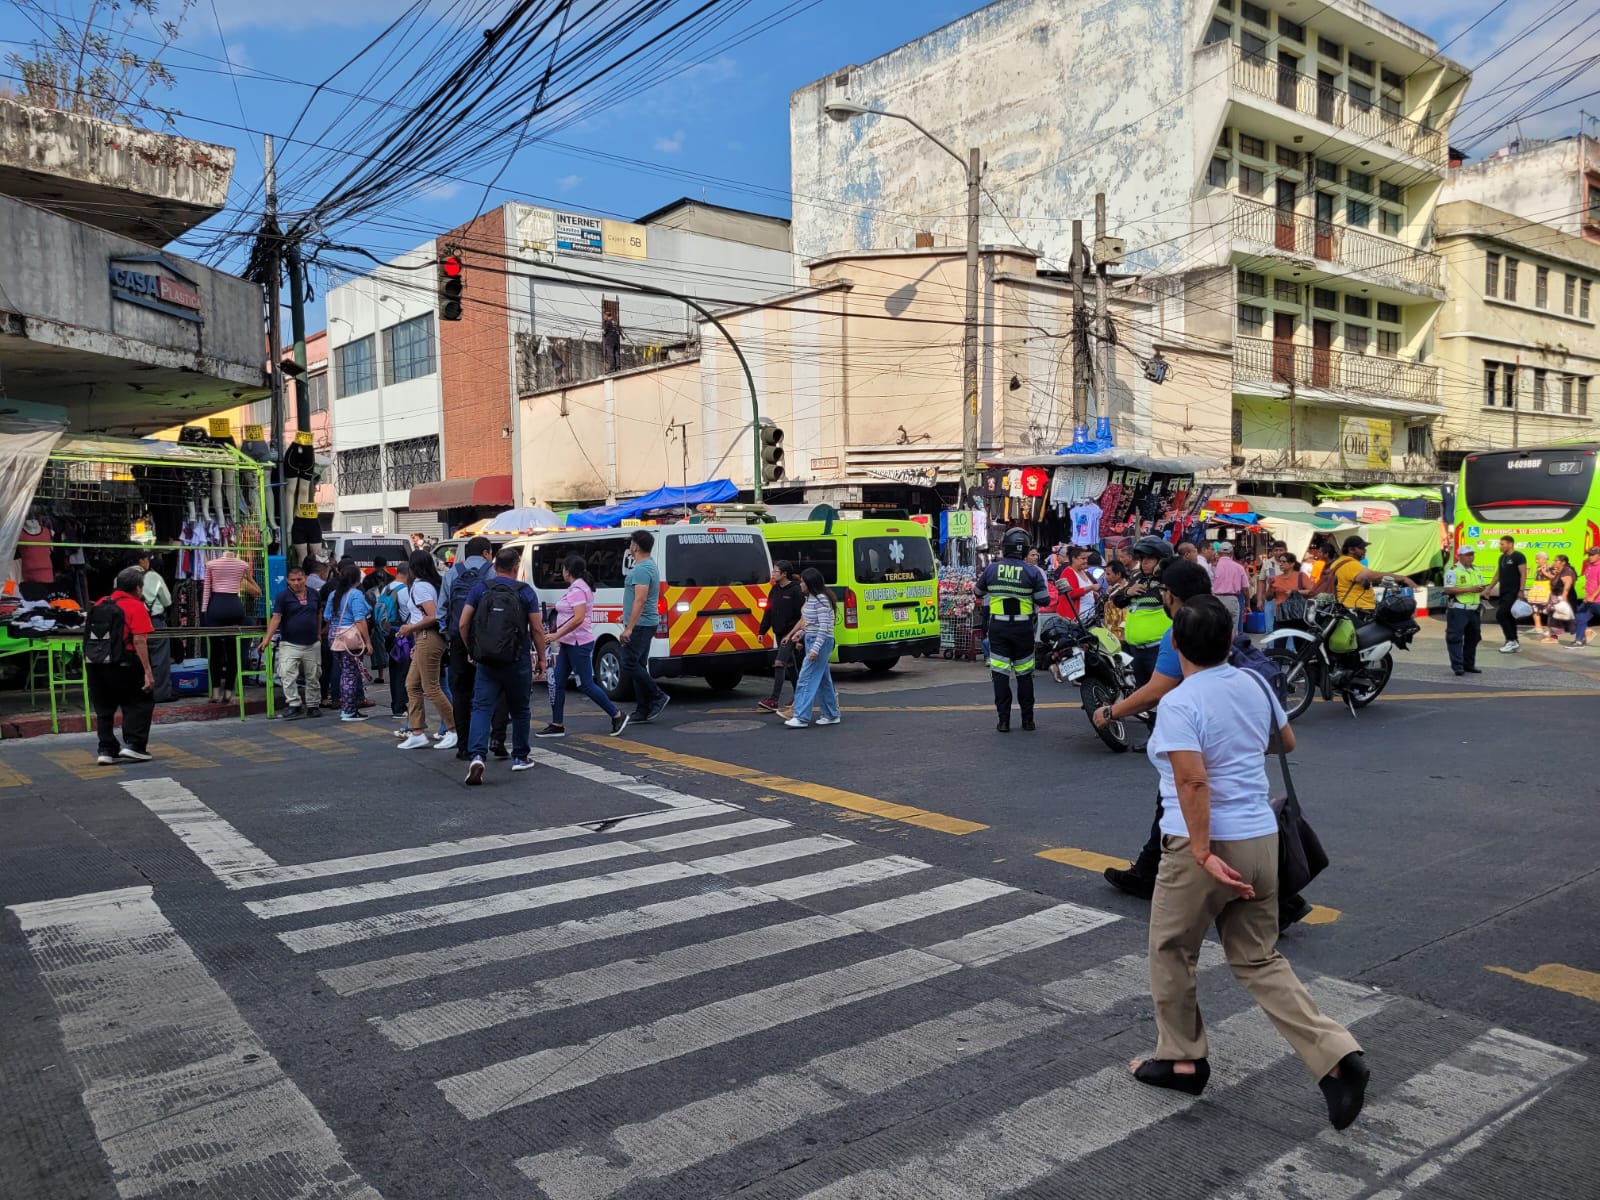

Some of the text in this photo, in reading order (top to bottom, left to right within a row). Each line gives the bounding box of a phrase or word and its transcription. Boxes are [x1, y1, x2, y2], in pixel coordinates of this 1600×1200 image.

[557, 214, 600, 229] INTERNET
[630, 237, 641, 247] 5B
[113, 269, 160, 298] CASA
[1560, 462, 1576, 472] 87
[953, 513, 967, 526] 10
[679, 535, 753, 544] BOMBEROS VOLUNTARIOS
[884, 572, 914, 580] TERCERA
[997, 564, 1023, 580] PMT
[914, 605, 936, 624] 123
[875, 627, 926, 640] GUATEMALA
